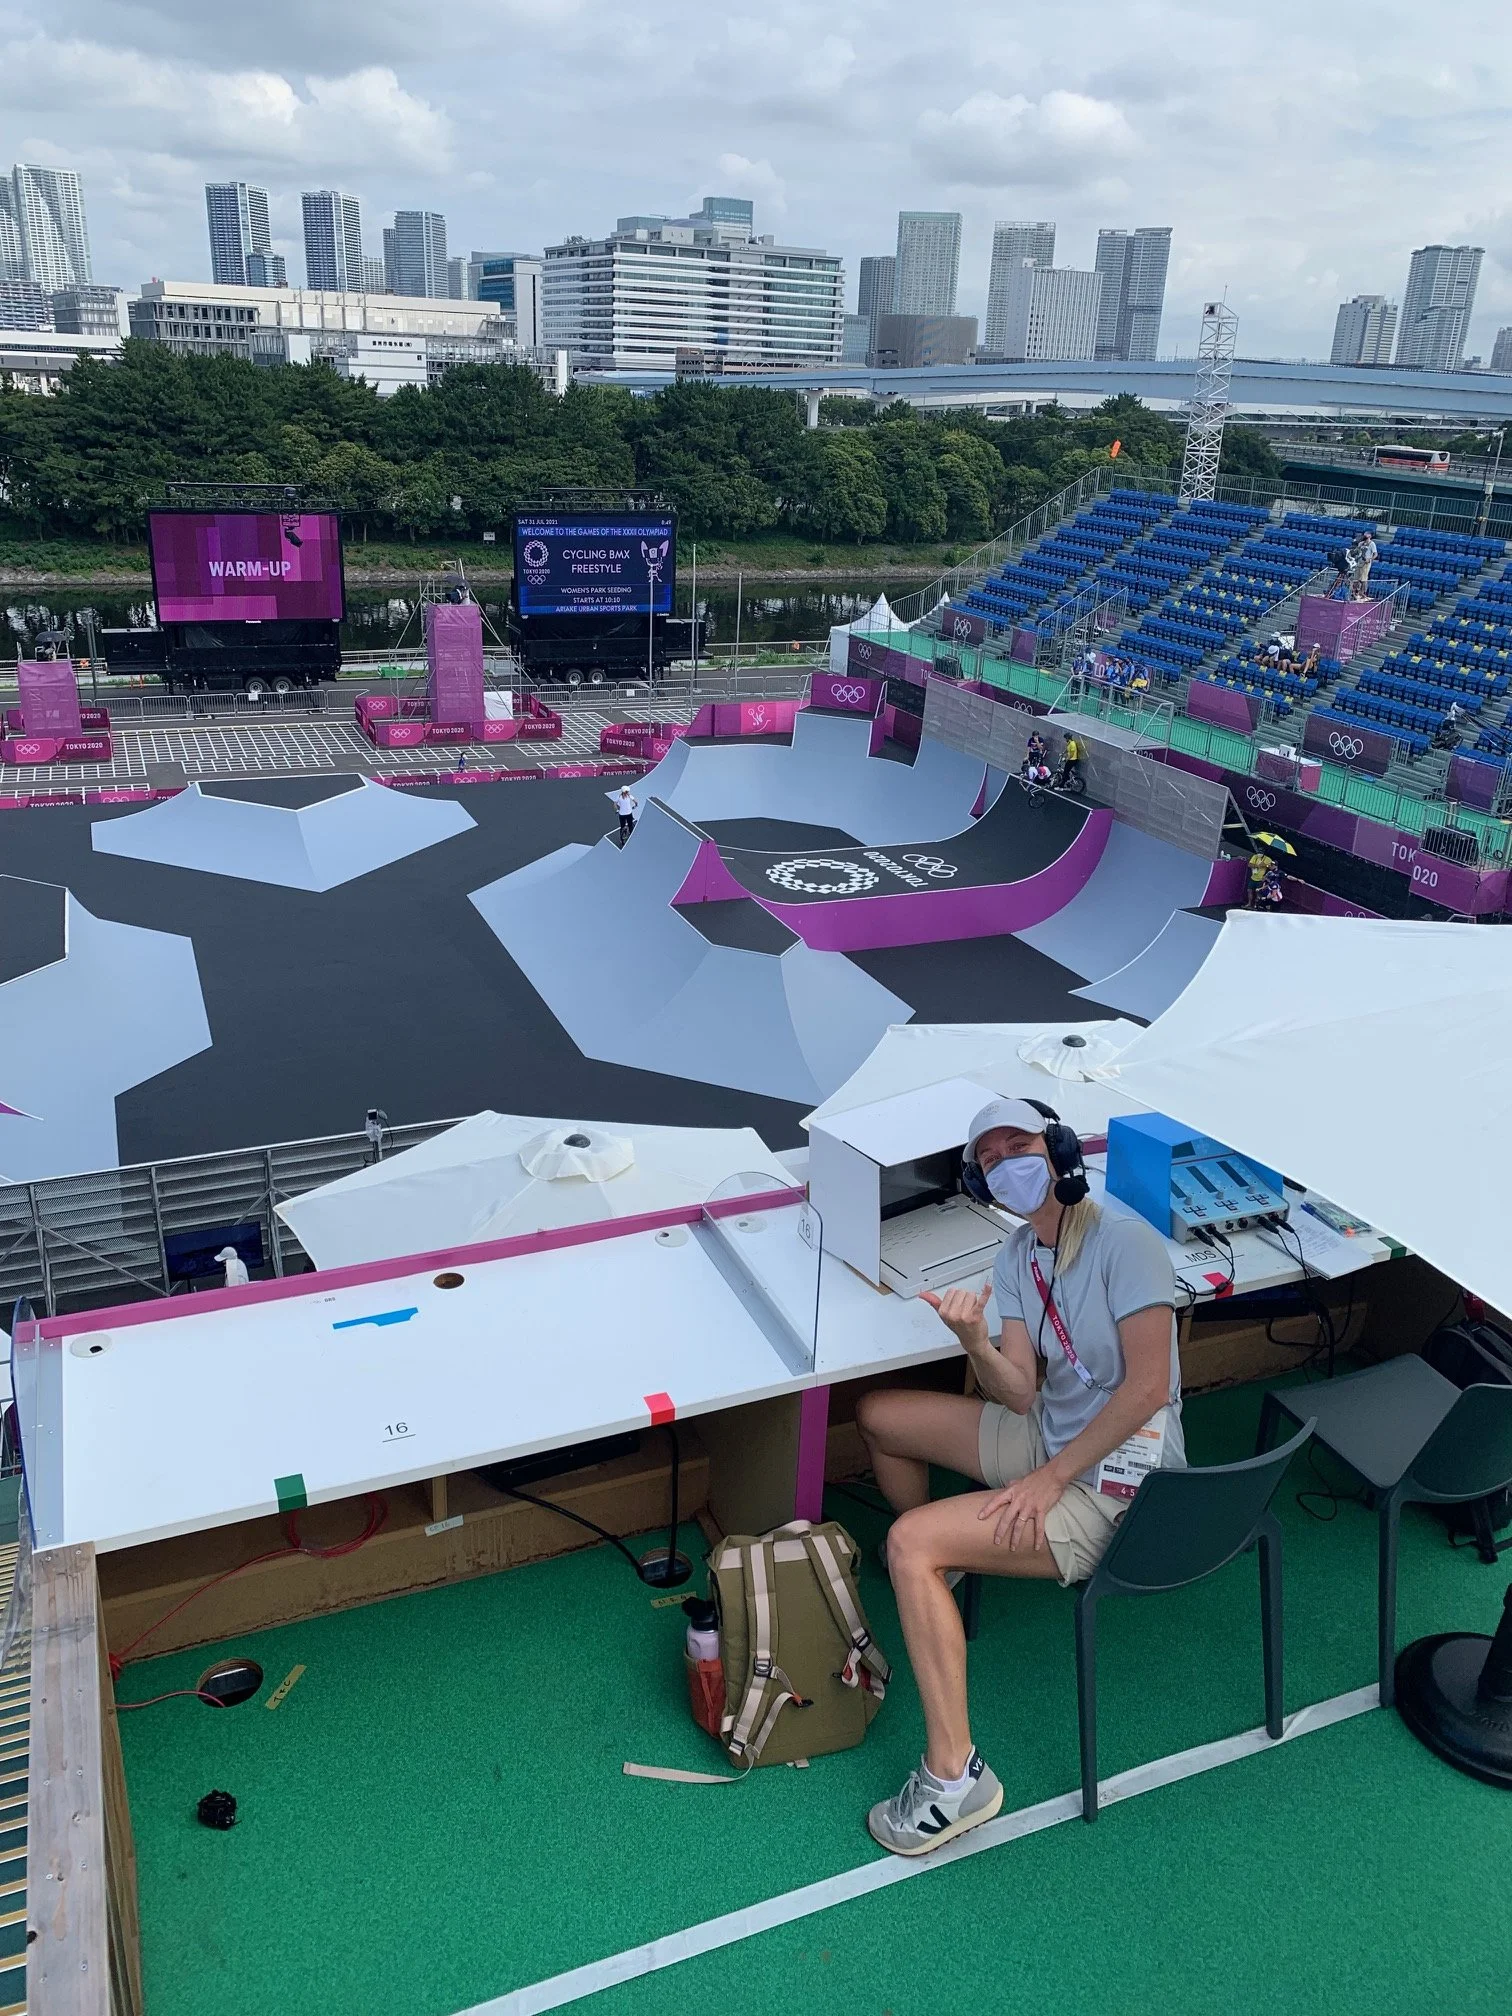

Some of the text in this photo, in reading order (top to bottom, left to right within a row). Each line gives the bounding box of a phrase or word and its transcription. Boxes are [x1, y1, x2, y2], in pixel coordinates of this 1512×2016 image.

[562, 550, 630, 559] CYCLING BMX
[208, 561, 291, 577] WARM-UP
[572, 564, 622, 573] FREESTYLE
[863, 852, 928, 887] TOKYO 2020
[1392, 842, 1438, 887] TOK 020
[801, 1219, 810, 1239] 16
[1185, 1250, 1217, 1263] MDS
[1052, 1315, 1075, 1359] TOKYO 2020
[384, 1422, 408, 1436] 16
